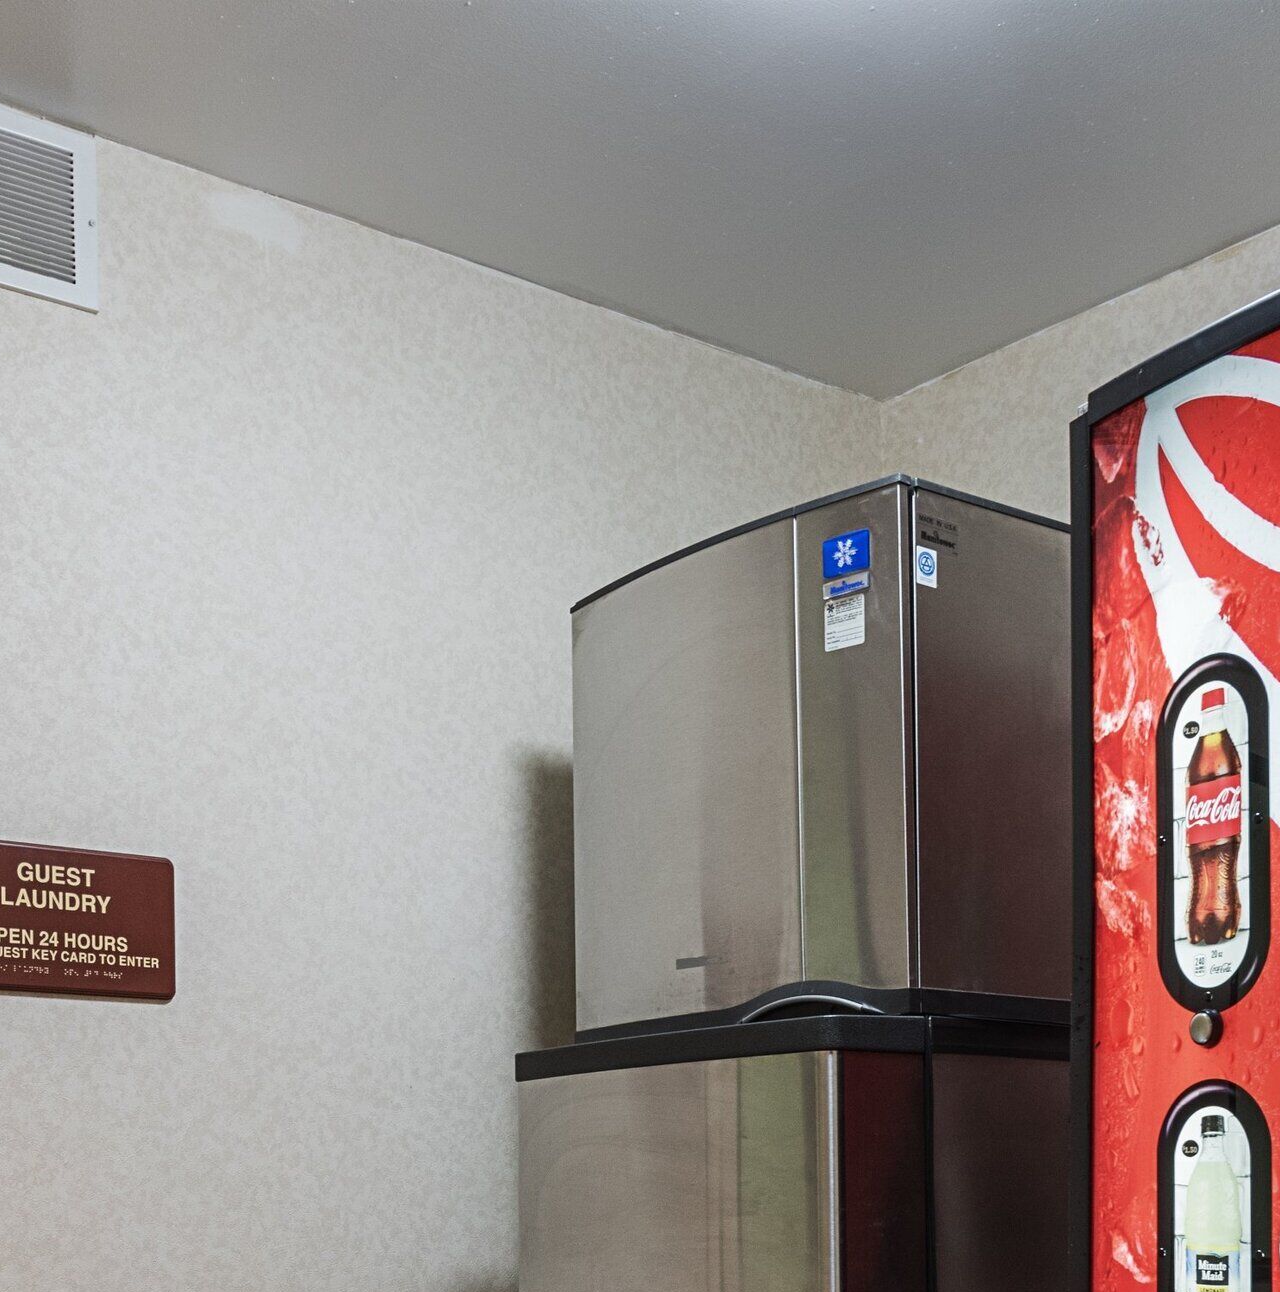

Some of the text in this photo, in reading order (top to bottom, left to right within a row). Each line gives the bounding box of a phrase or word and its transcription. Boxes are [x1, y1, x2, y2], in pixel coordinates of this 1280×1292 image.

[1186, 786, 1240, 828] Coca-Cola
[16, 862, 95, 887] GUEST
[1, 886, 111, 914] LAUNDRY
[39, 931, 59, 947] 24
[64, 932, 128, 952] HOURS
[32, 948, 58, 961] KEY
[61, 950, 95, 964] CARD
[99, 954, 115, 965] TO
[119, 956, 159, 968] ENTER
[1198, 1260, 1227, 1271] Minute
[1201, 1270, 1224, 1281] Maid
